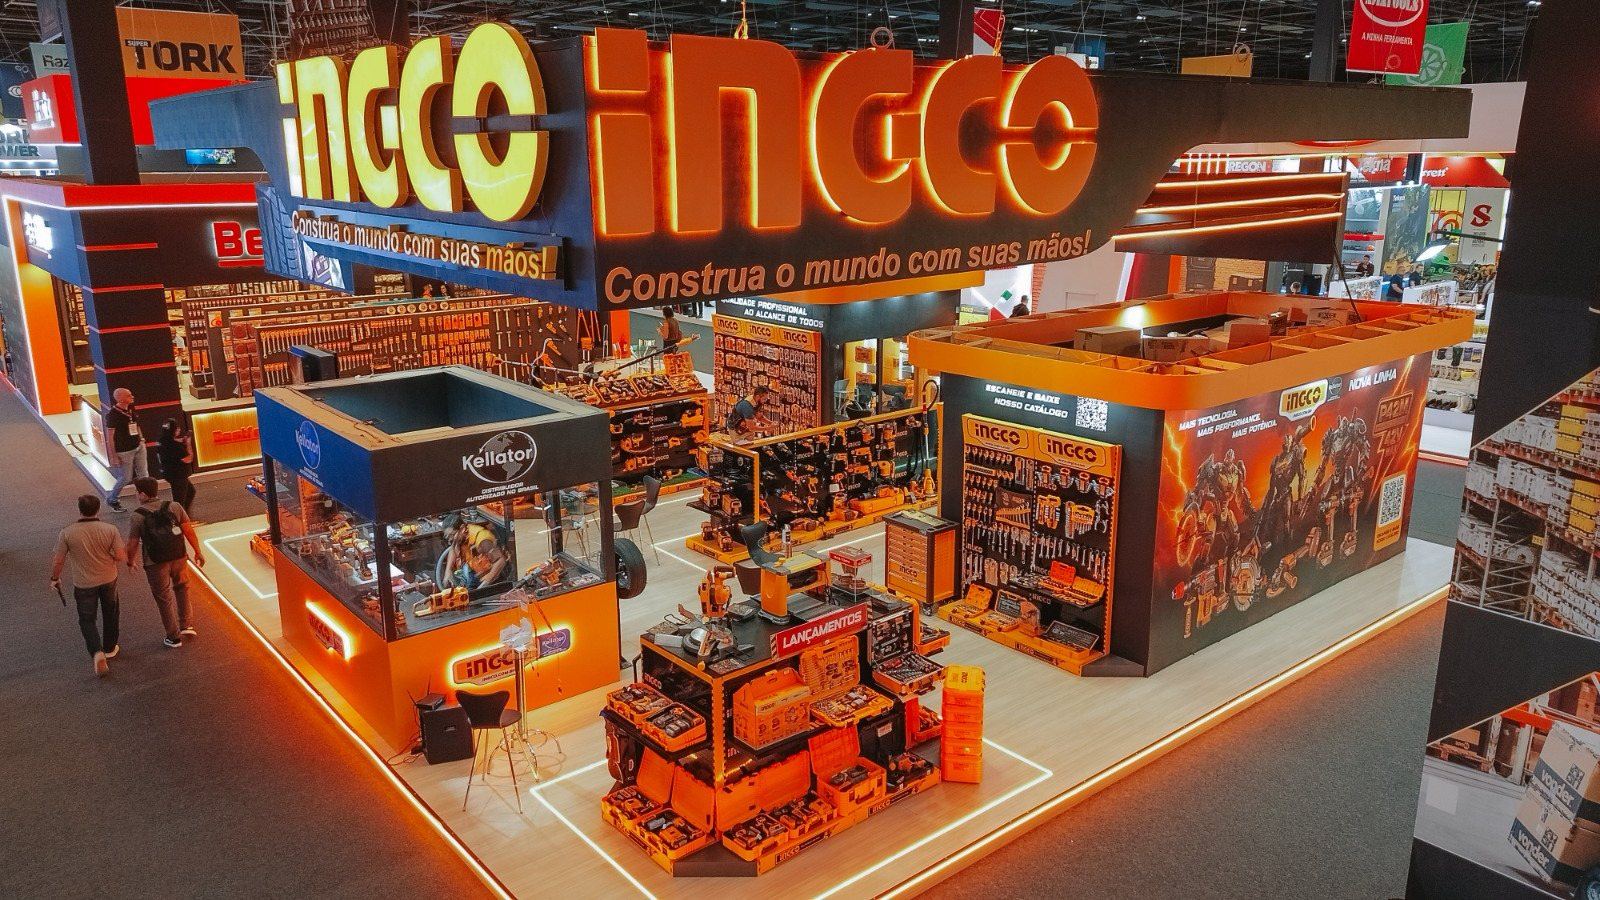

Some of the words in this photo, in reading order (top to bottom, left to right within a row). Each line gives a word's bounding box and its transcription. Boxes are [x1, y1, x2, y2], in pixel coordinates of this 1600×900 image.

[126, 40, 148, 48] SUPER
[132, 41, 236, 74] TORK
[1471, 204, 1492, 226] S
[292, 210, 341, 243] Construa
[343, 226, 351, 244] o
[354, 224, 399, 254] mundo
[404, 235, 436, 259] com
[440, 238, 480, 268] suas
[486, 242, 549, 280] mãos!
[604, 262, 767, 305] Construa
[776, 264, 796, 288] o
[804, 247, 901, 286] mundo
[908, 241, 962, 272] com
[966, 239, 1021, 268] suas
[1026, 229, 1092, 260] mãos!
[1348, 376, 1372, 392] NOVA
[1374, 368, 1397, 385] LINHA
[985, 384, 1026, 398] ESCANEIE
[1034, 394, 1060, 404] BAIXE
[994, 398, 1023, 410] NOSSO
[1024, 404, 1069, 418] CATÁLOGO
[462, 448, 533, 470] Kellator
[466, 490, 506, 502] AUTORIZADO
[782, 610, 862, 649] LANÇAMENTOS
[1541, 769, 1576, 807] vonder
[1519, 831, 1550, 869] vonder
